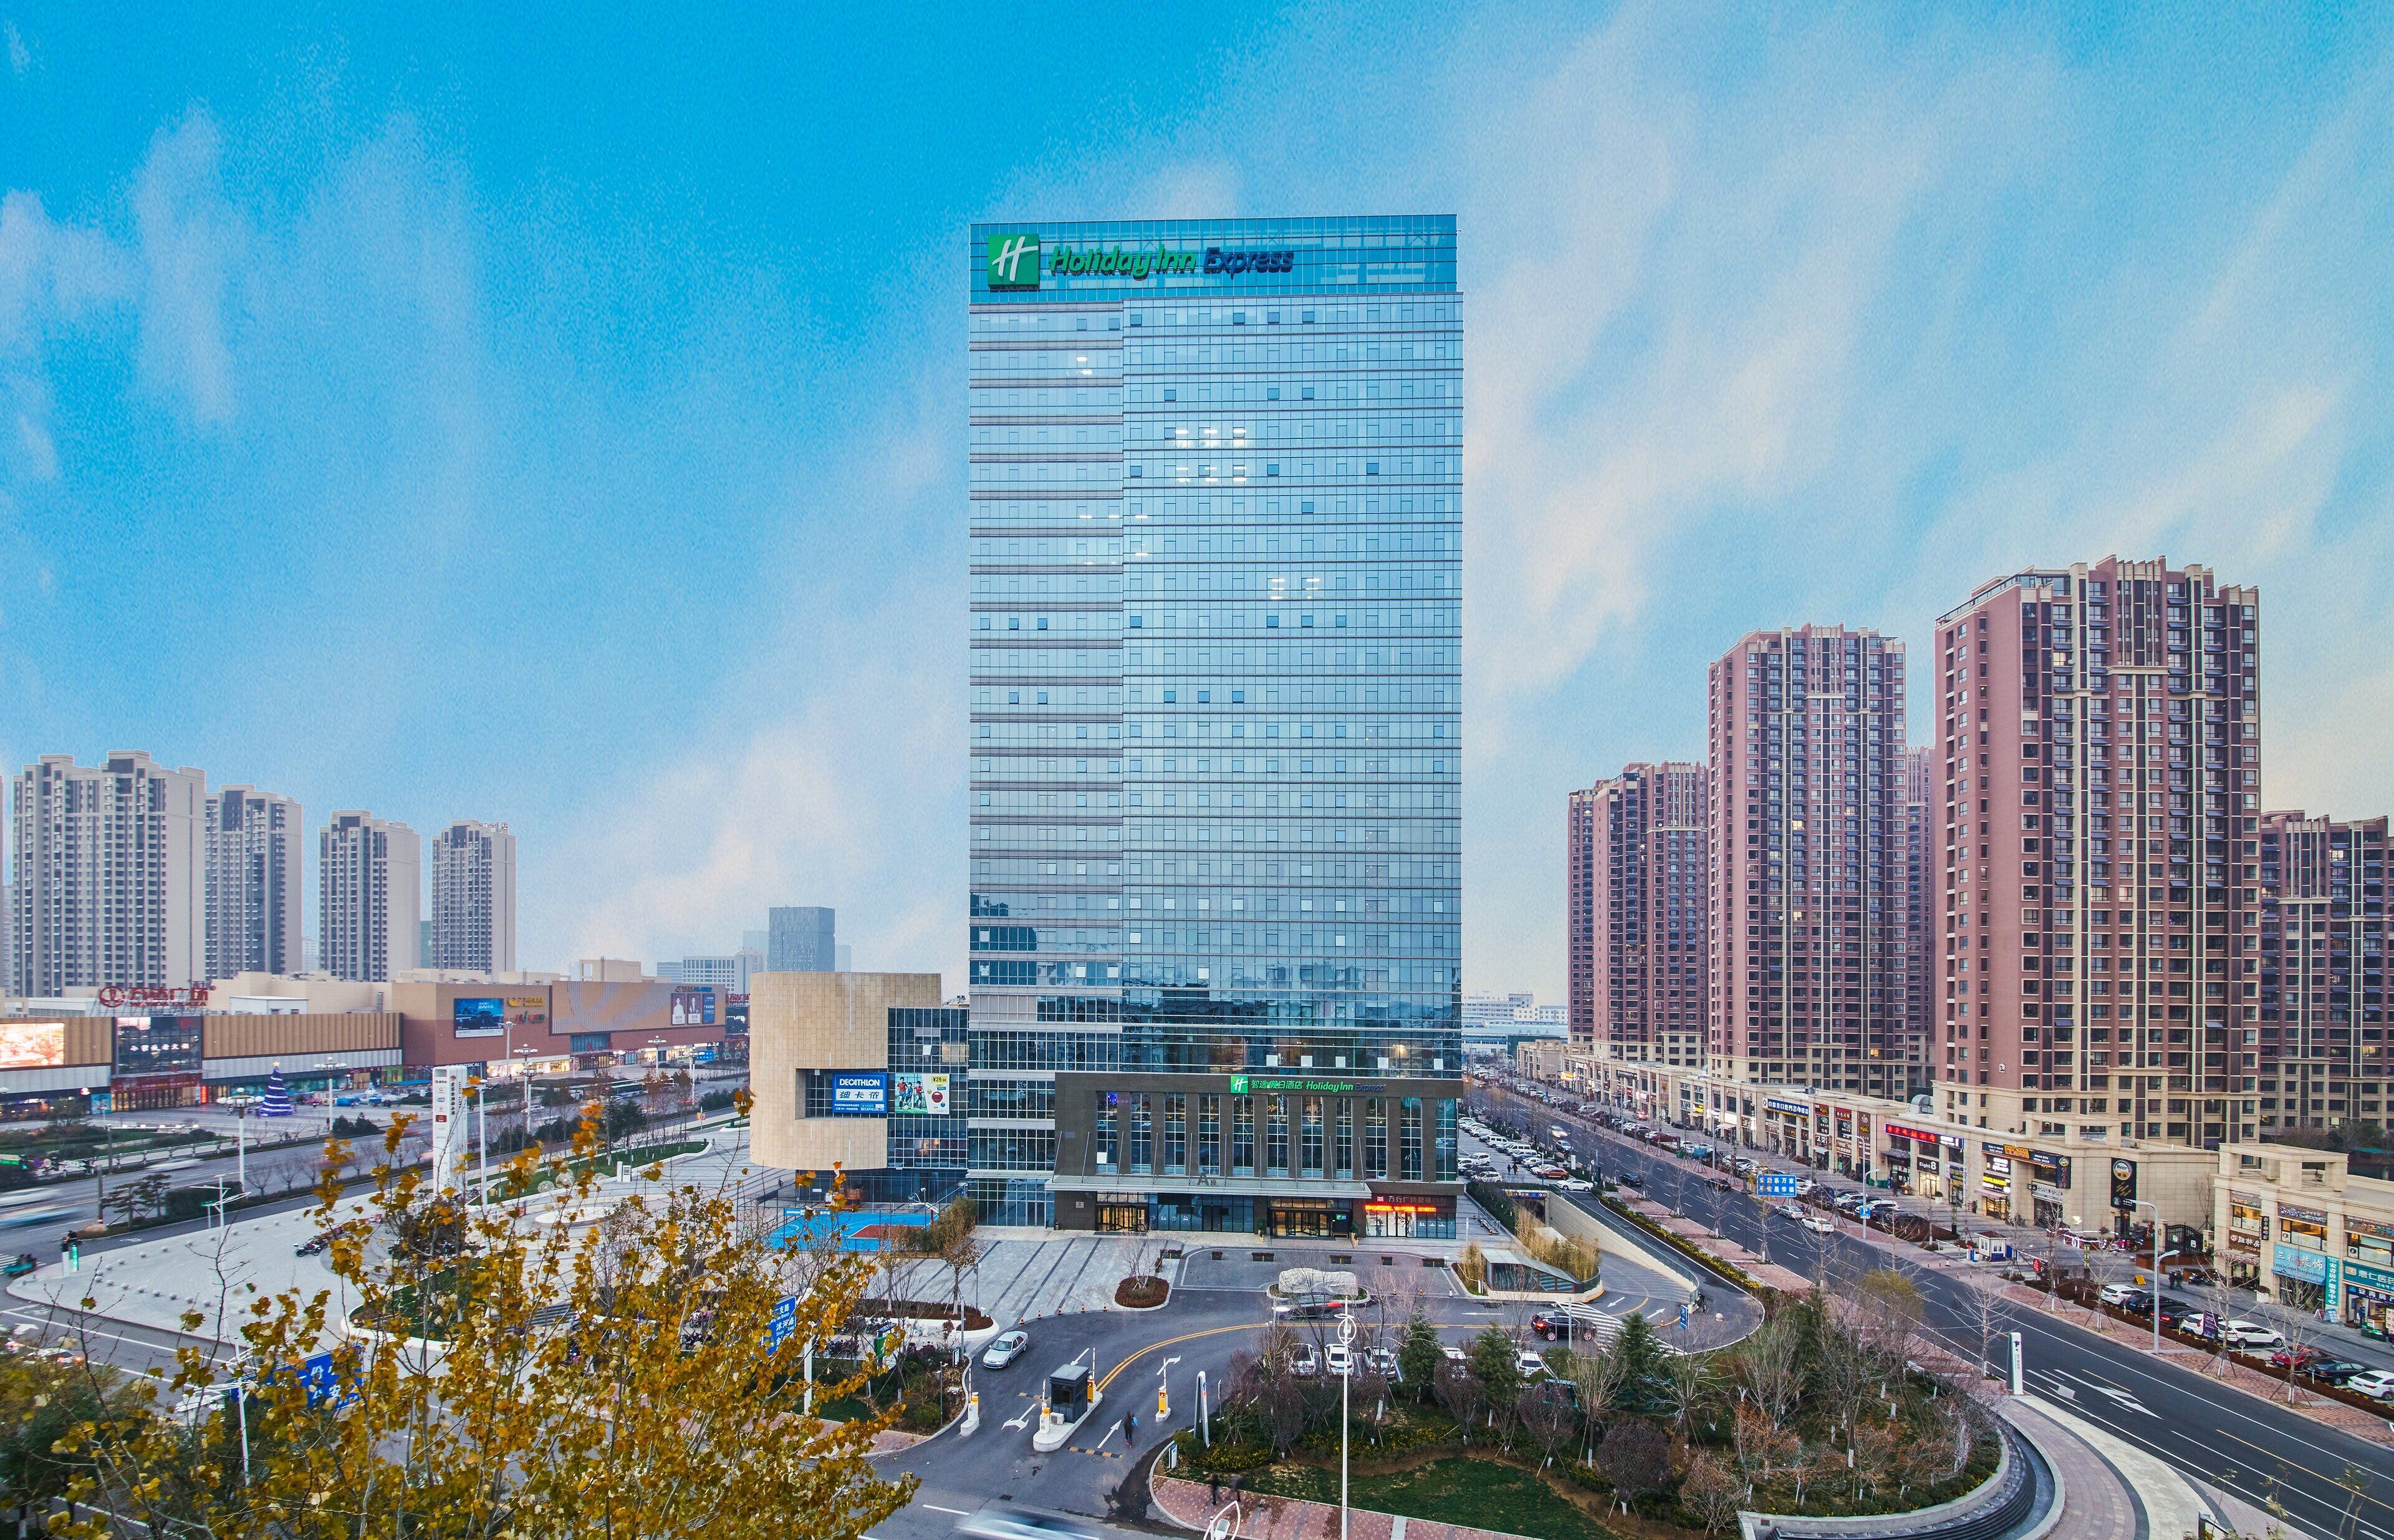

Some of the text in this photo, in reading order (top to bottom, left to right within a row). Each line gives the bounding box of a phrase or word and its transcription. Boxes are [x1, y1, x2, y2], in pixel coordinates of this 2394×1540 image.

[1049, 244, 1294, 281] Holiday Inn Express
[839, 1079, 880, 1087] DECATHLON
[1251, 1079, 1303, 1090] 智选假日酒店
[1306, 1080, 1384, 1092] Holiday Inn Express
[839, 1090, 880, 1099] 迪卡侬
[1919, 1161, 1937, 1170] Eight 8
